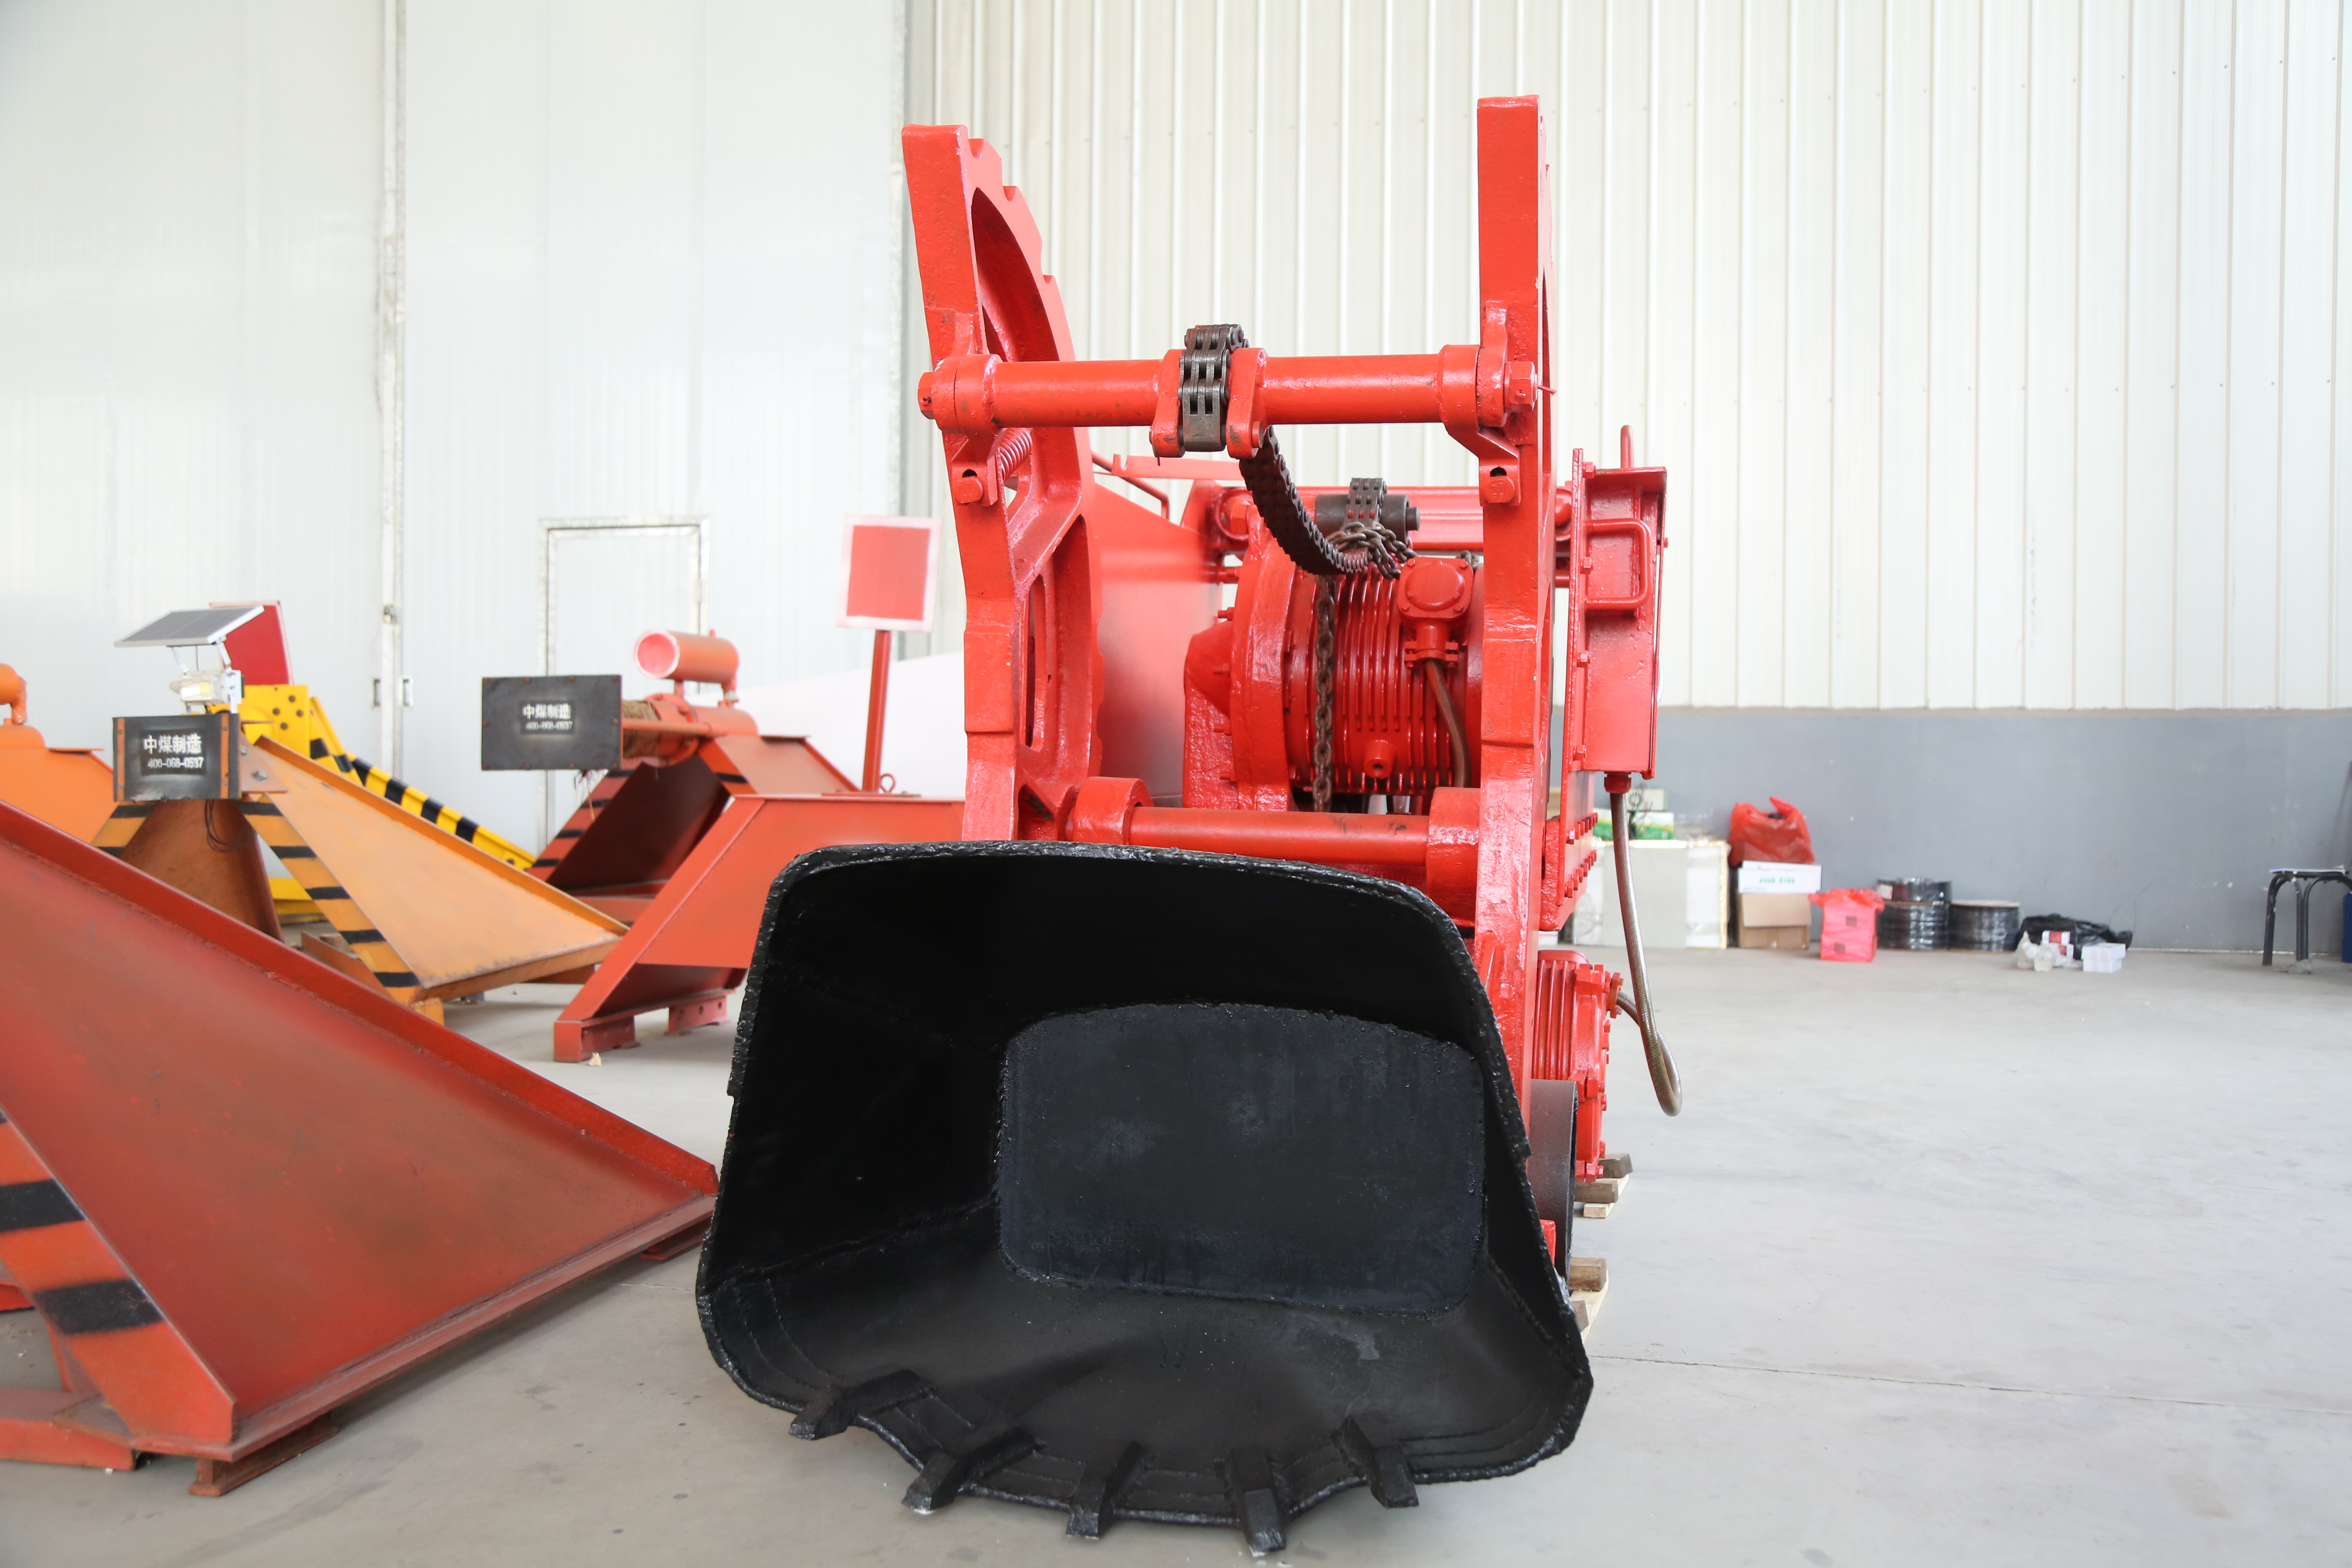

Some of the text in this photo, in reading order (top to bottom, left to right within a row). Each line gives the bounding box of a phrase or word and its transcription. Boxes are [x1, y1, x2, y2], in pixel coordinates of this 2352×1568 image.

[144, 733, 202, 755] 中煤制造
[147, 756, 204, 768] 400-068-0537
